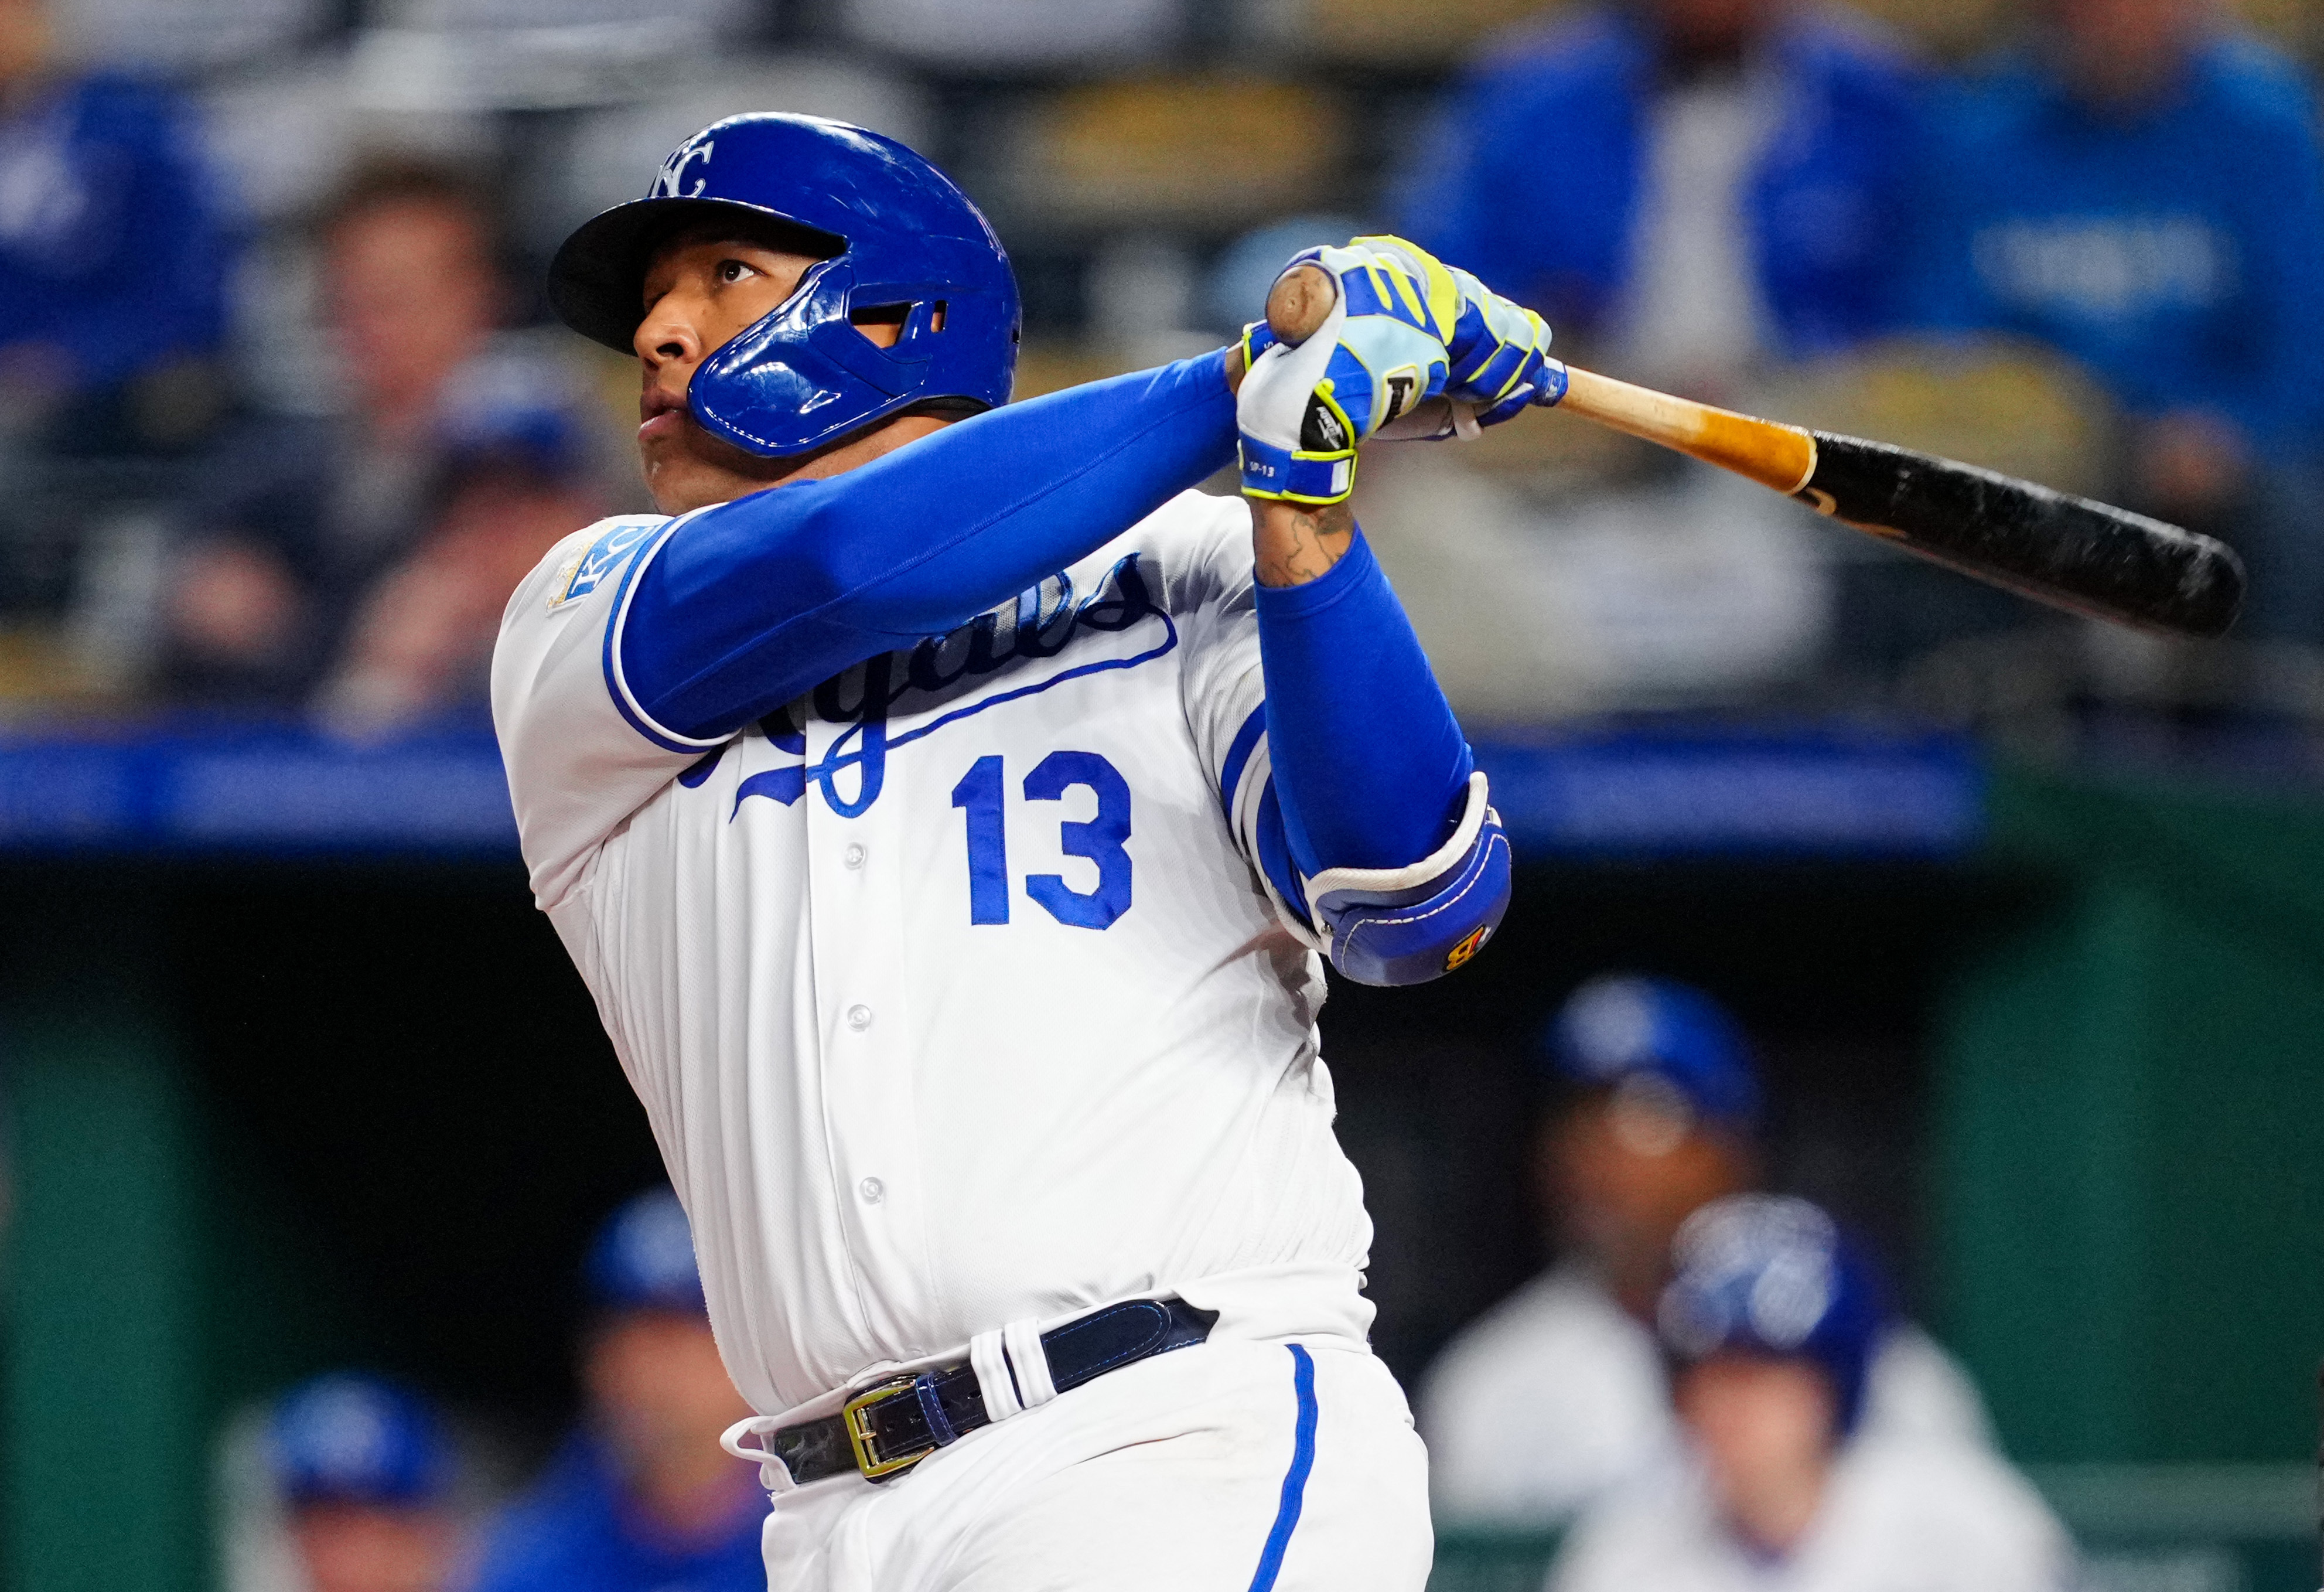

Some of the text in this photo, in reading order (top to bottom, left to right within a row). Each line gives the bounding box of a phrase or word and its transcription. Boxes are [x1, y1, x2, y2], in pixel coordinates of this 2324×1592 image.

[649, 140, 714, 197] KC
[571, 527, 655, 594] KC
[952, 751, 1132, 930] 13
